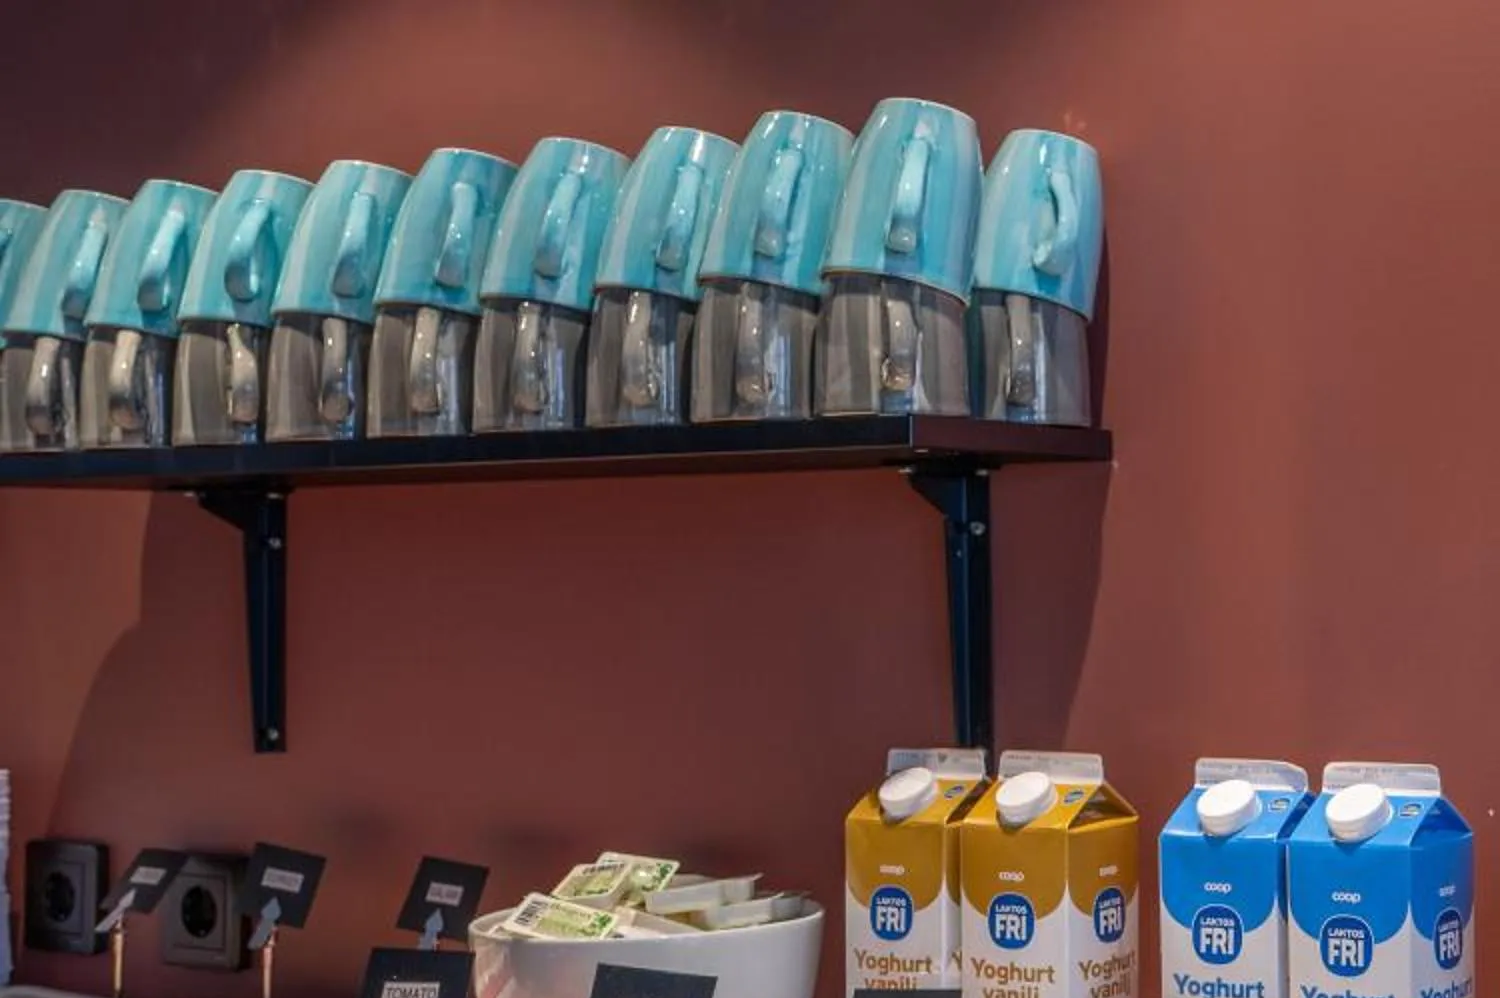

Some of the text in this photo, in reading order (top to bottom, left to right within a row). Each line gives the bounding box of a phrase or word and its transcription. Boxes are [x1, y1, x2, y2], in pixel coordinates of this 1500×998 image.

[1204, 881, 1232, 894] coop
[1331, 891, 1361, 903] coop
[875, 907, 905, 932] FRI
[995, 914, 1027, 940] FRI
[1100, 906, 1122, 936] FRI
[1328, 927, 1364, 938] LAKTOS
[1200, 927, 1235, 955] FRI
[1328, 938, 1364, 967] FRI
[1440, 931, 1459, 961] FRI
[854, 950, 932, 975] Yoghurt
[970, 957, 1056, 985] Yoghurt
